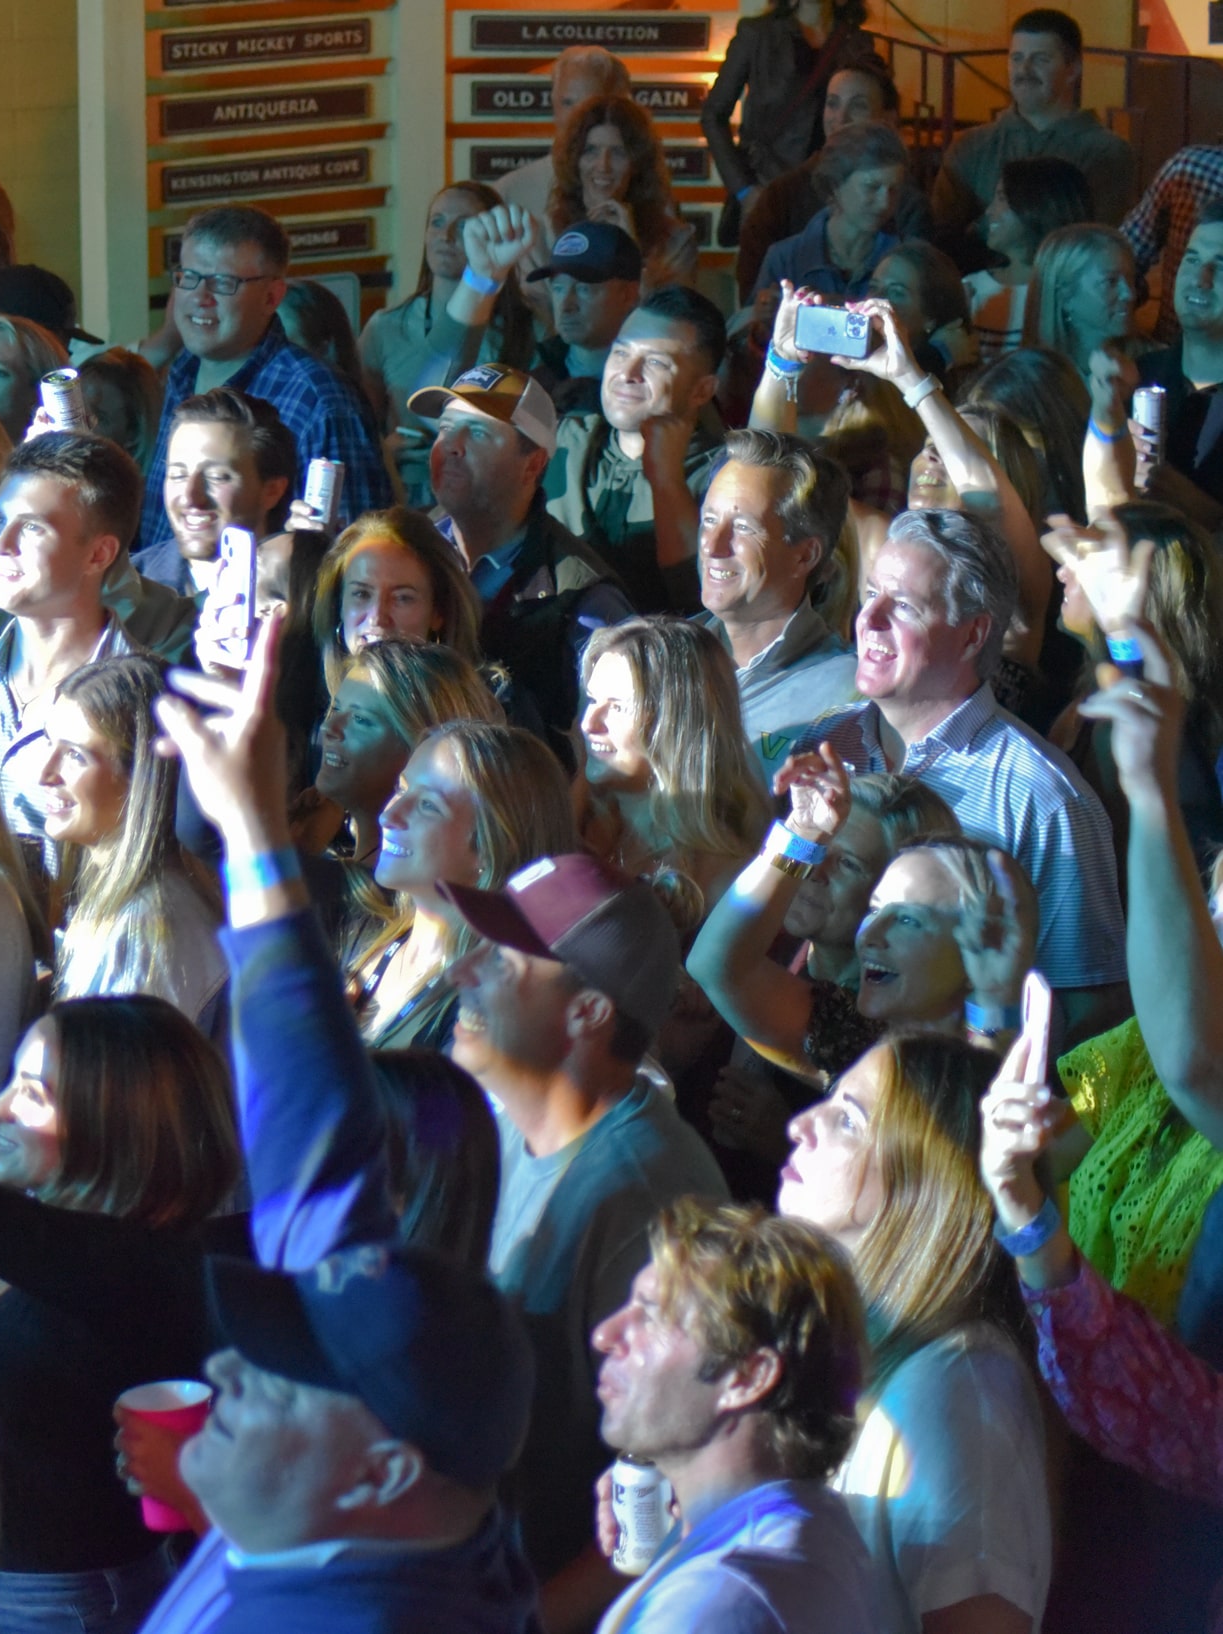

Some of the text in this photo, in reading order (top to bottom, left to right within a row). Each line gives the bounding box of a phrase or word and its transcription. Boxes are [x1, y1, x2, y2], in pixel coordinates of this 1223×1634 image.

[171, 30, 363, 59] STICKY MICKEY SPORTS
[553, 25, 659, 41] COLLECTION
[213, 98, 319, 121] ANTIQUERIA
[492, 90, 534, 107] OLD
[631, 90, 688, 107] GAIN
[171, 159, 360, 190] KENSINGTON ANTIQUE COVE
